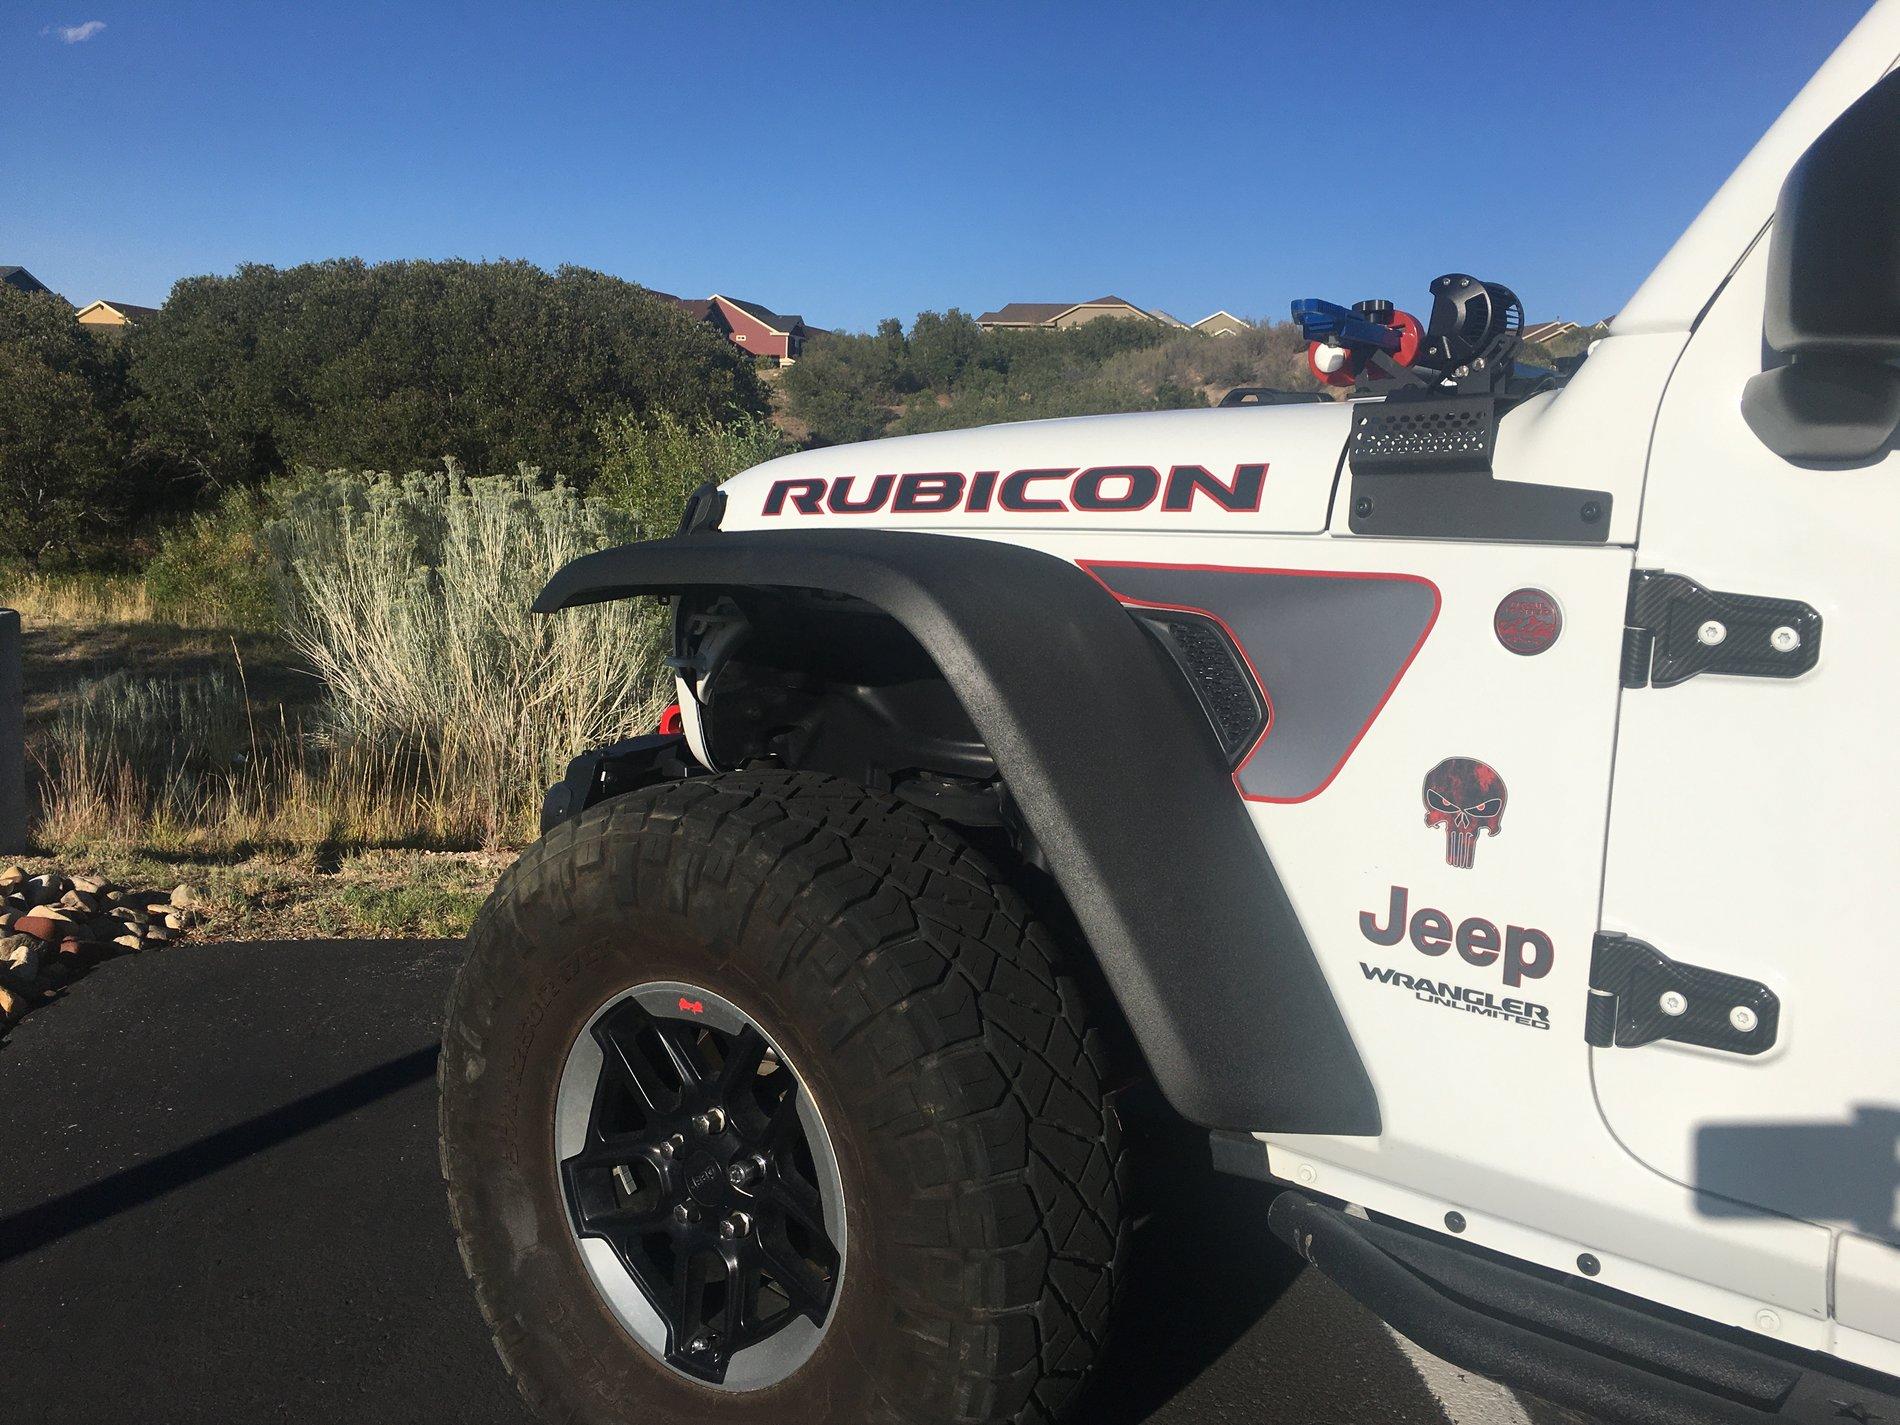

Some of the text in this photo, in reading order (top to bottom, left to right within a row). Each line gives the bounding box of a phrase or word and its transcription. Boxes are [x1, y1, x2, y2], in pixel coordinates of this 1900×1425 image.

[761, 463, 1270, 516] RUBICON
[1359, 885, 1554, 988] Jeep
[1359, 961, 1549, 1022] WRANGLER
[1415, 992, 1550, 1031] UNLIMITED
